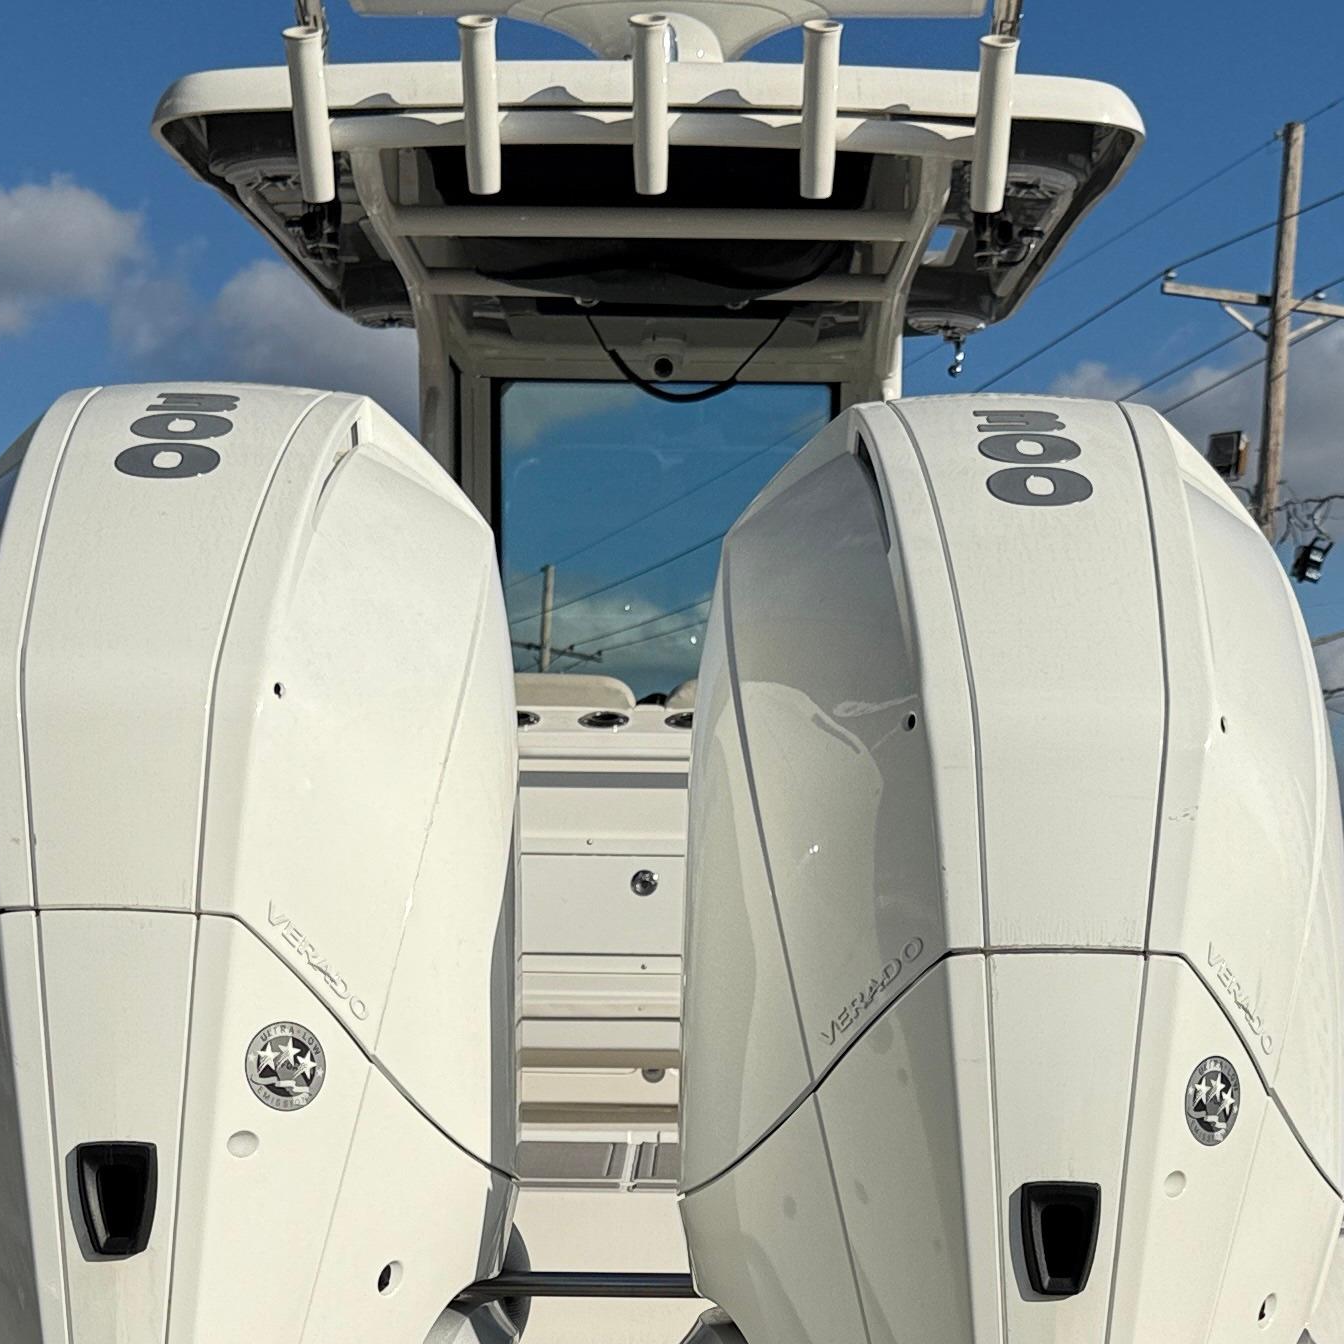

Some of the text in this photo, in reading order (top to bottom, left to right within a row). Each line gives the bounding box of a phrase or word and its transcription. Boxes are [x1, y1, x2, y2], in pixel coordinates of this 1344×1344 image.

[266, 898, 369, 1021] VERADO
[819, 936, 924, 1046] VERADO
[1207, 940, 1273, 1056] VERADO
